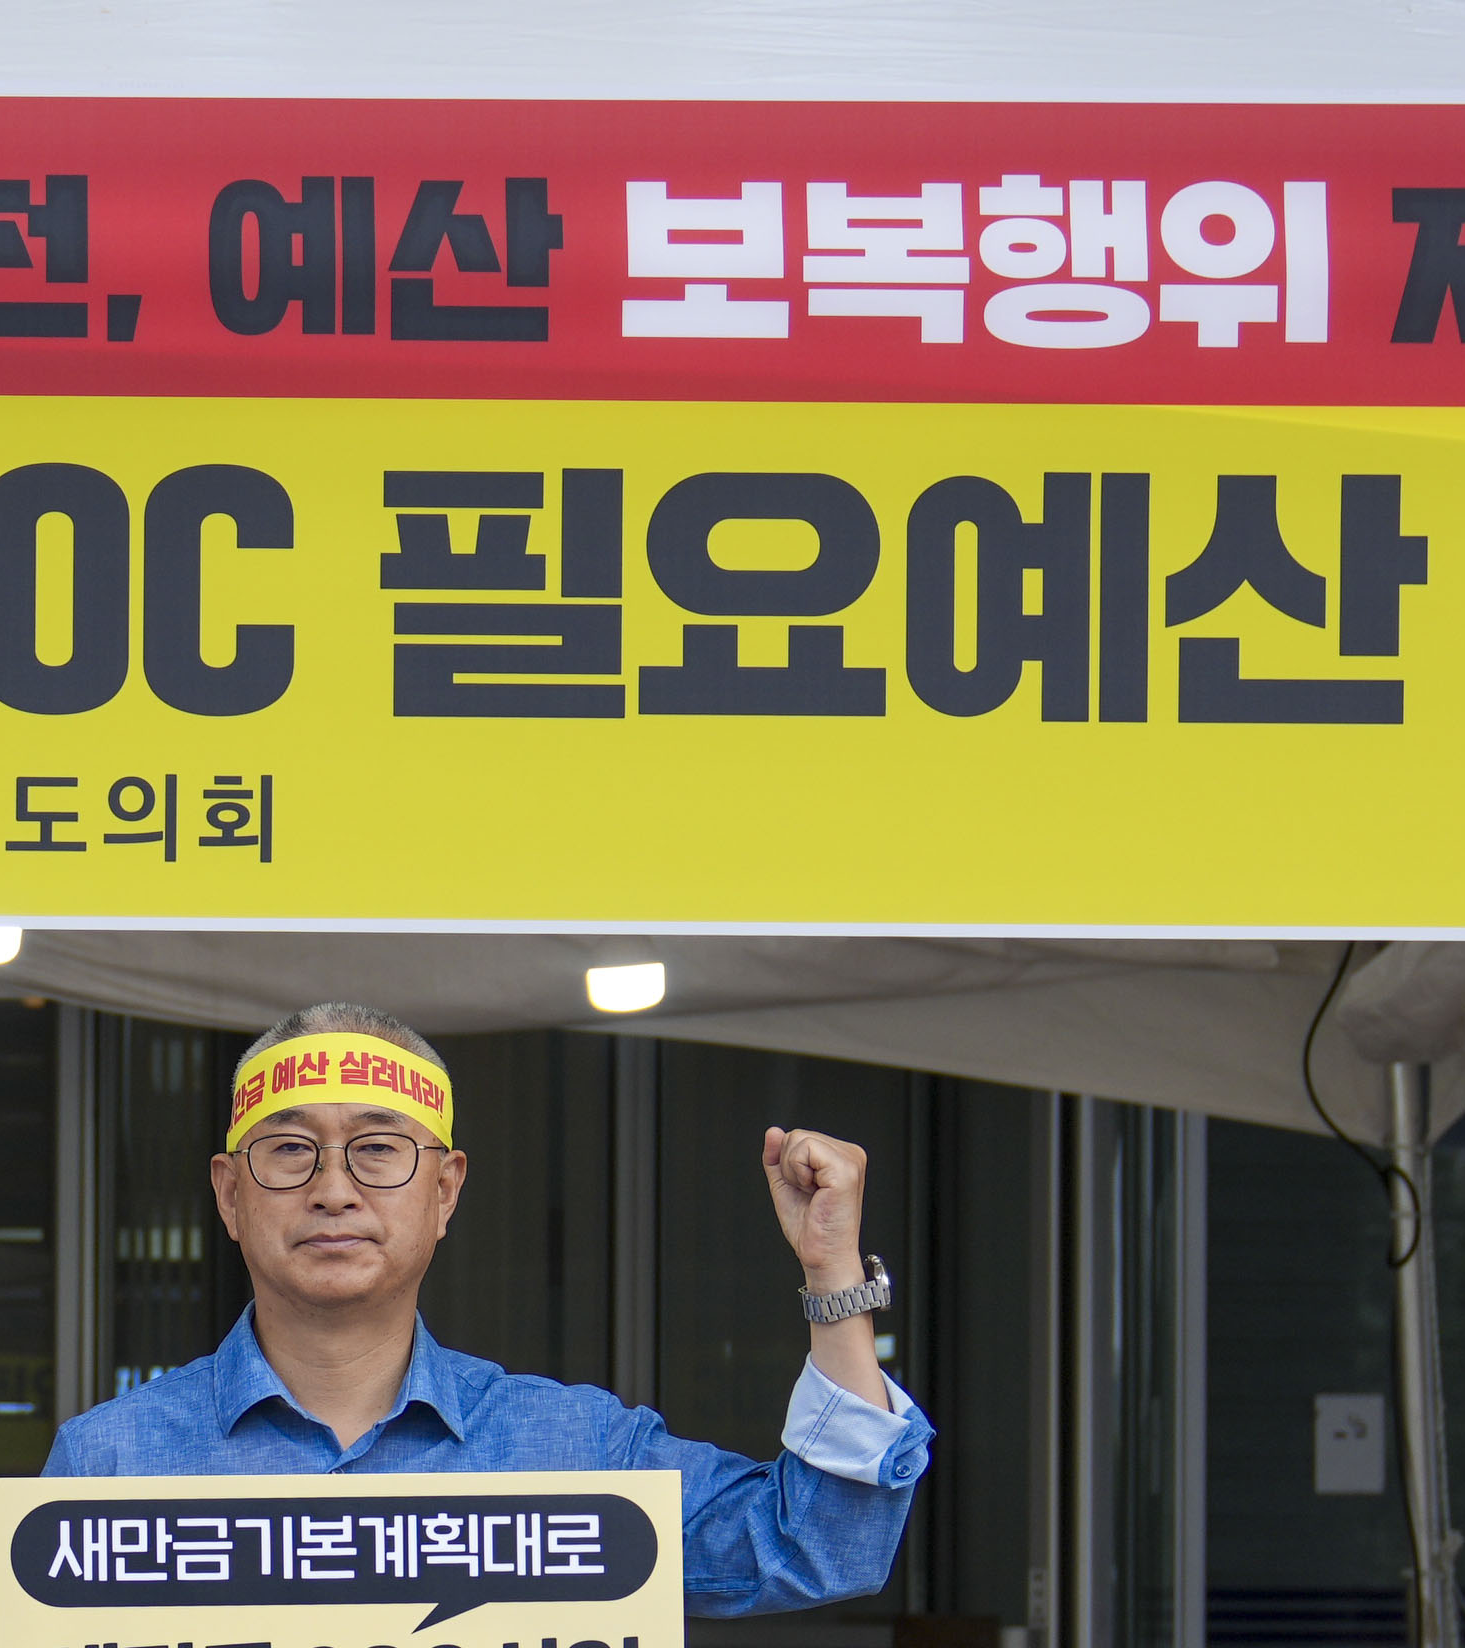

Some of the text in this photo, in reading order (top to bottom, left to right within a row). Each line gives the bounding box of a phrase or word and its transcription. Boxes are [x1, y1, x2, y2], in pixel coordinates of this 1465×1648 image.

[208, 175, 565, 343] 예산
[621, 174, 1329, 349] 보복행위
[379, 468, 1429, 725] 필요예산
[229, 1051, 445, 1133] 만금 예산 살려내라!
[48, 1512, 605, 1582] 새만금기본계획대로
